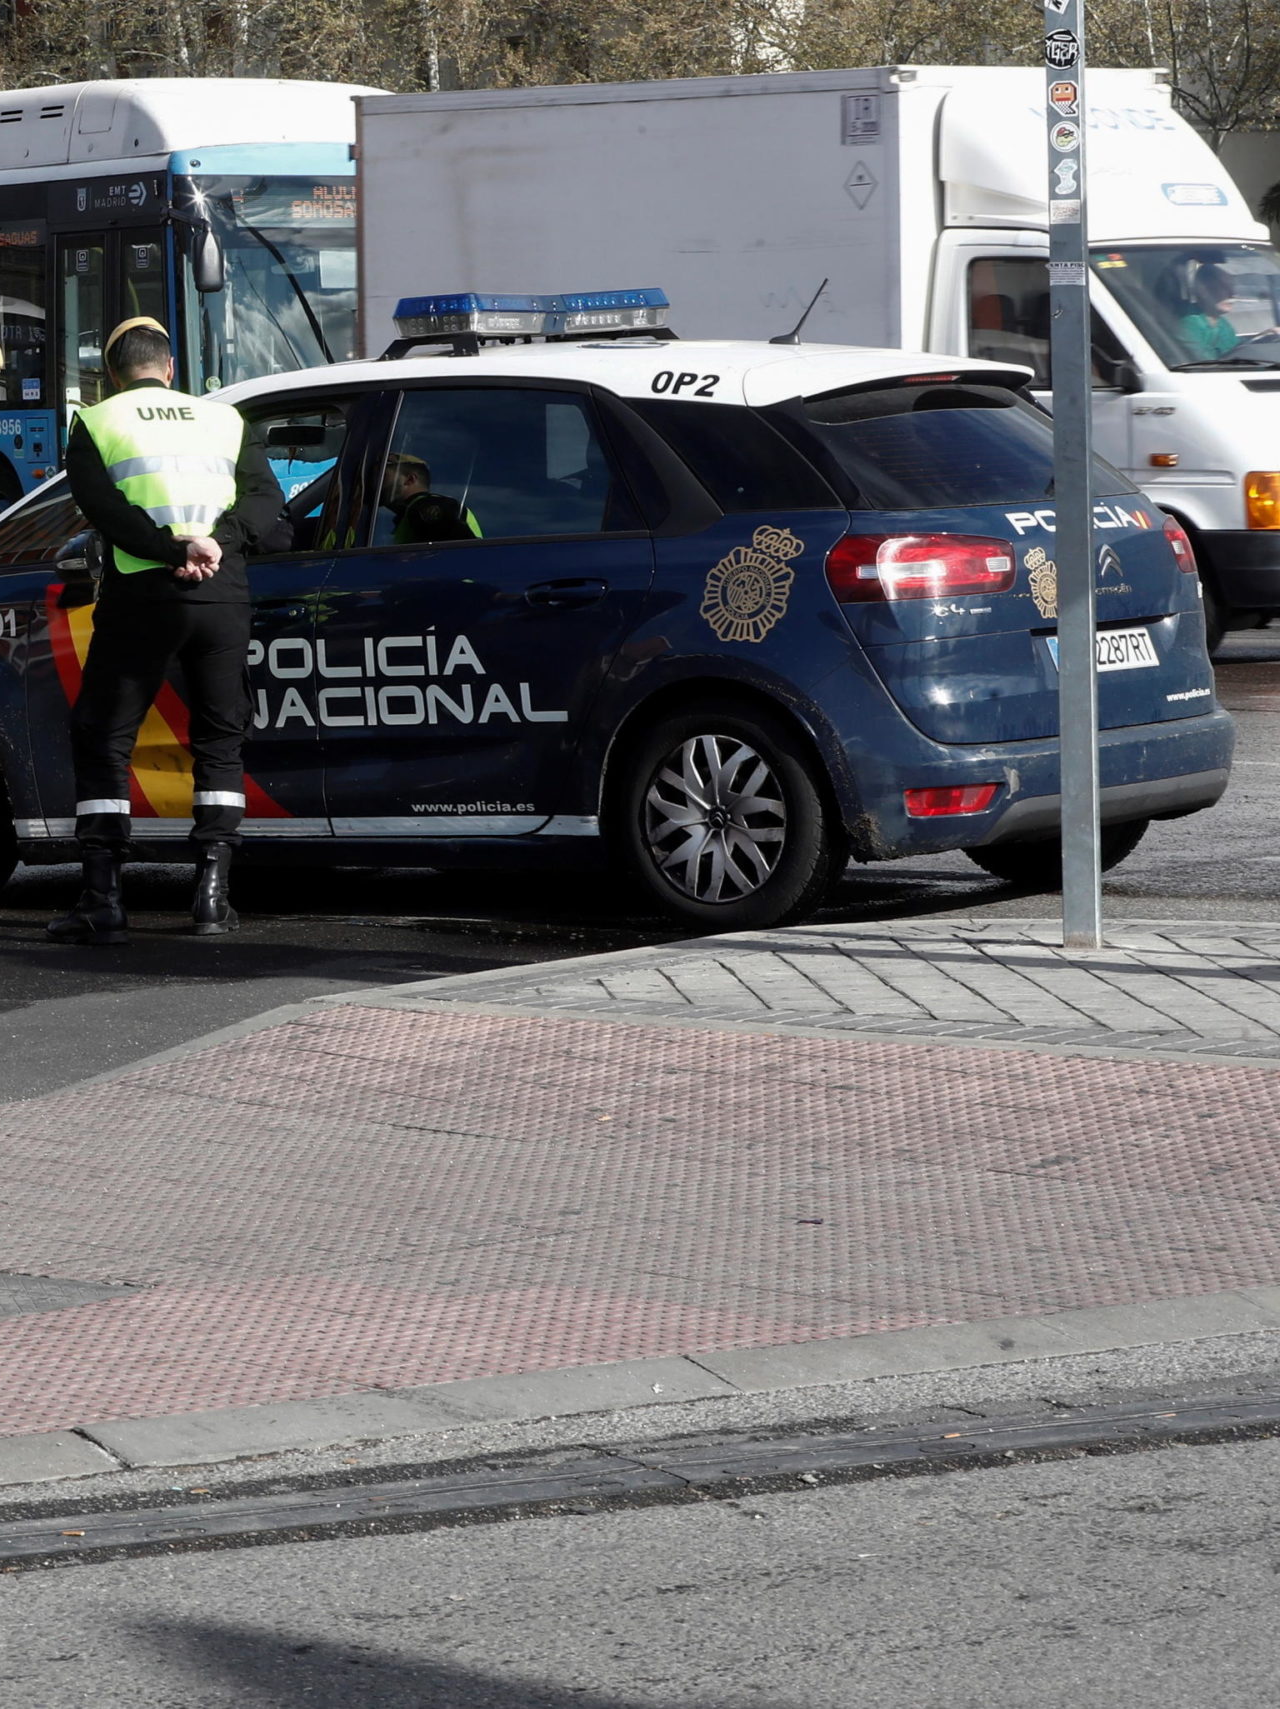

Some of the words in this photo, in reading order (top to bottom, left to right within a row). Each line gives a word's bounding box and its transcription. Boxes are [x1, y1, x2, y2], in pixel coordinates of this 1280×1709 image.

[109, 185, 126, 196] EMT
[94, 196, 127, 208] MADRID
[136, 407, 196, 421] UME
[1005, 502, 1141, 535] POCÍA
[411, 801, 535, 815] www.policia.es
